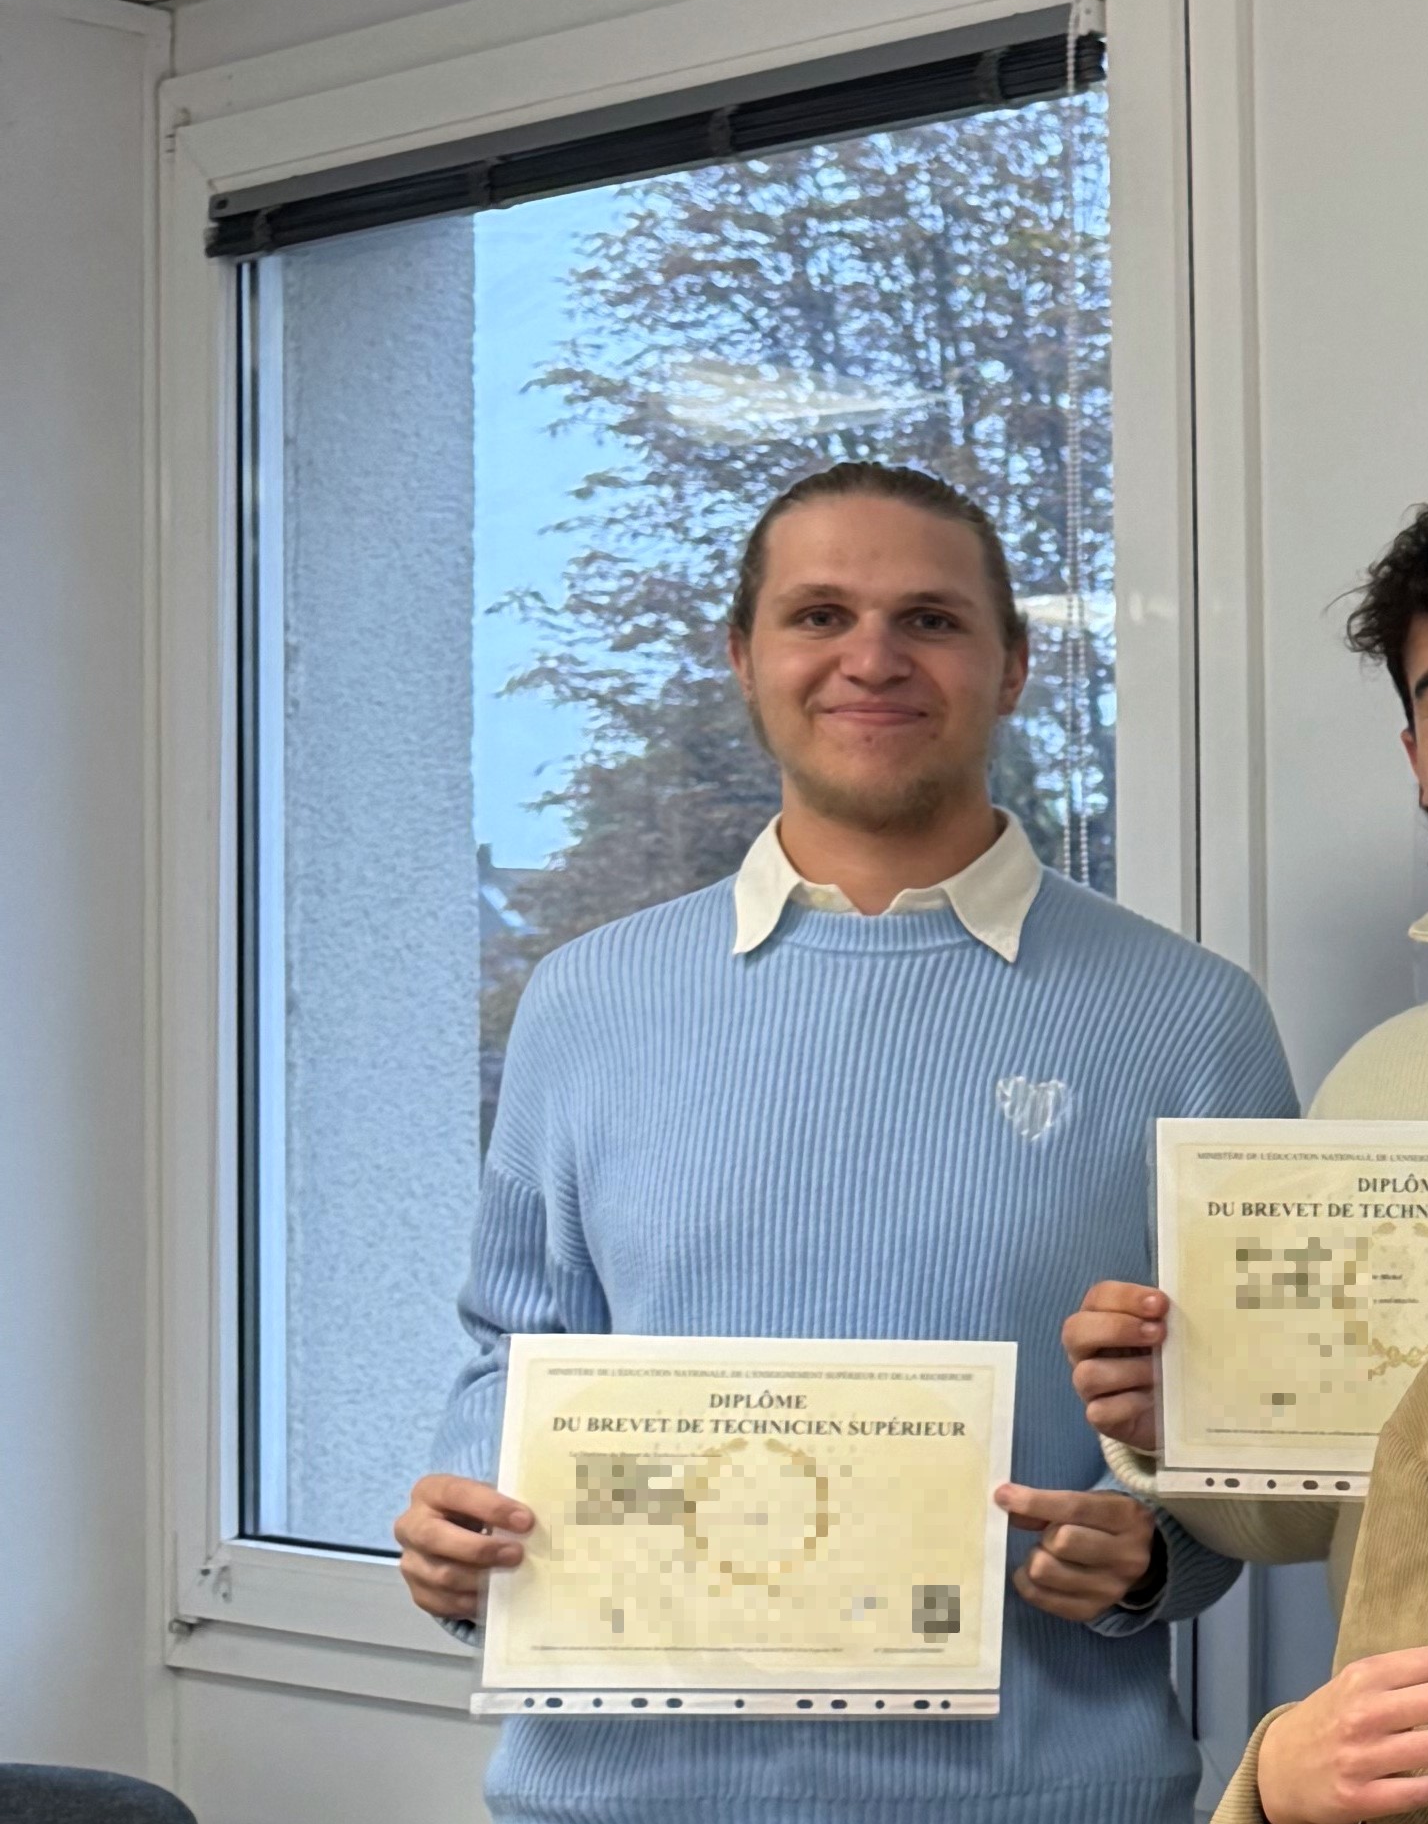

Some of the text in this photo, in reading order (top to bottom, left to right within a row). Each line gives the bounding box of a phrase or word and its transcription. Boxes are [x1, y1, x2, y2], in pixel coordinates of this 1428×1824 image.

[1207, 1201, 1235, 1217] DU
[1241, 1202, 1322, 1218] BREVET
[1327, 1203, 1354, 1218] DE
[709, 1389, 807, 1409] DIPLÔME
[553, 1417, 966, 1437] DU BREVET DE TECHNICIEN SUPÉRIEUR
